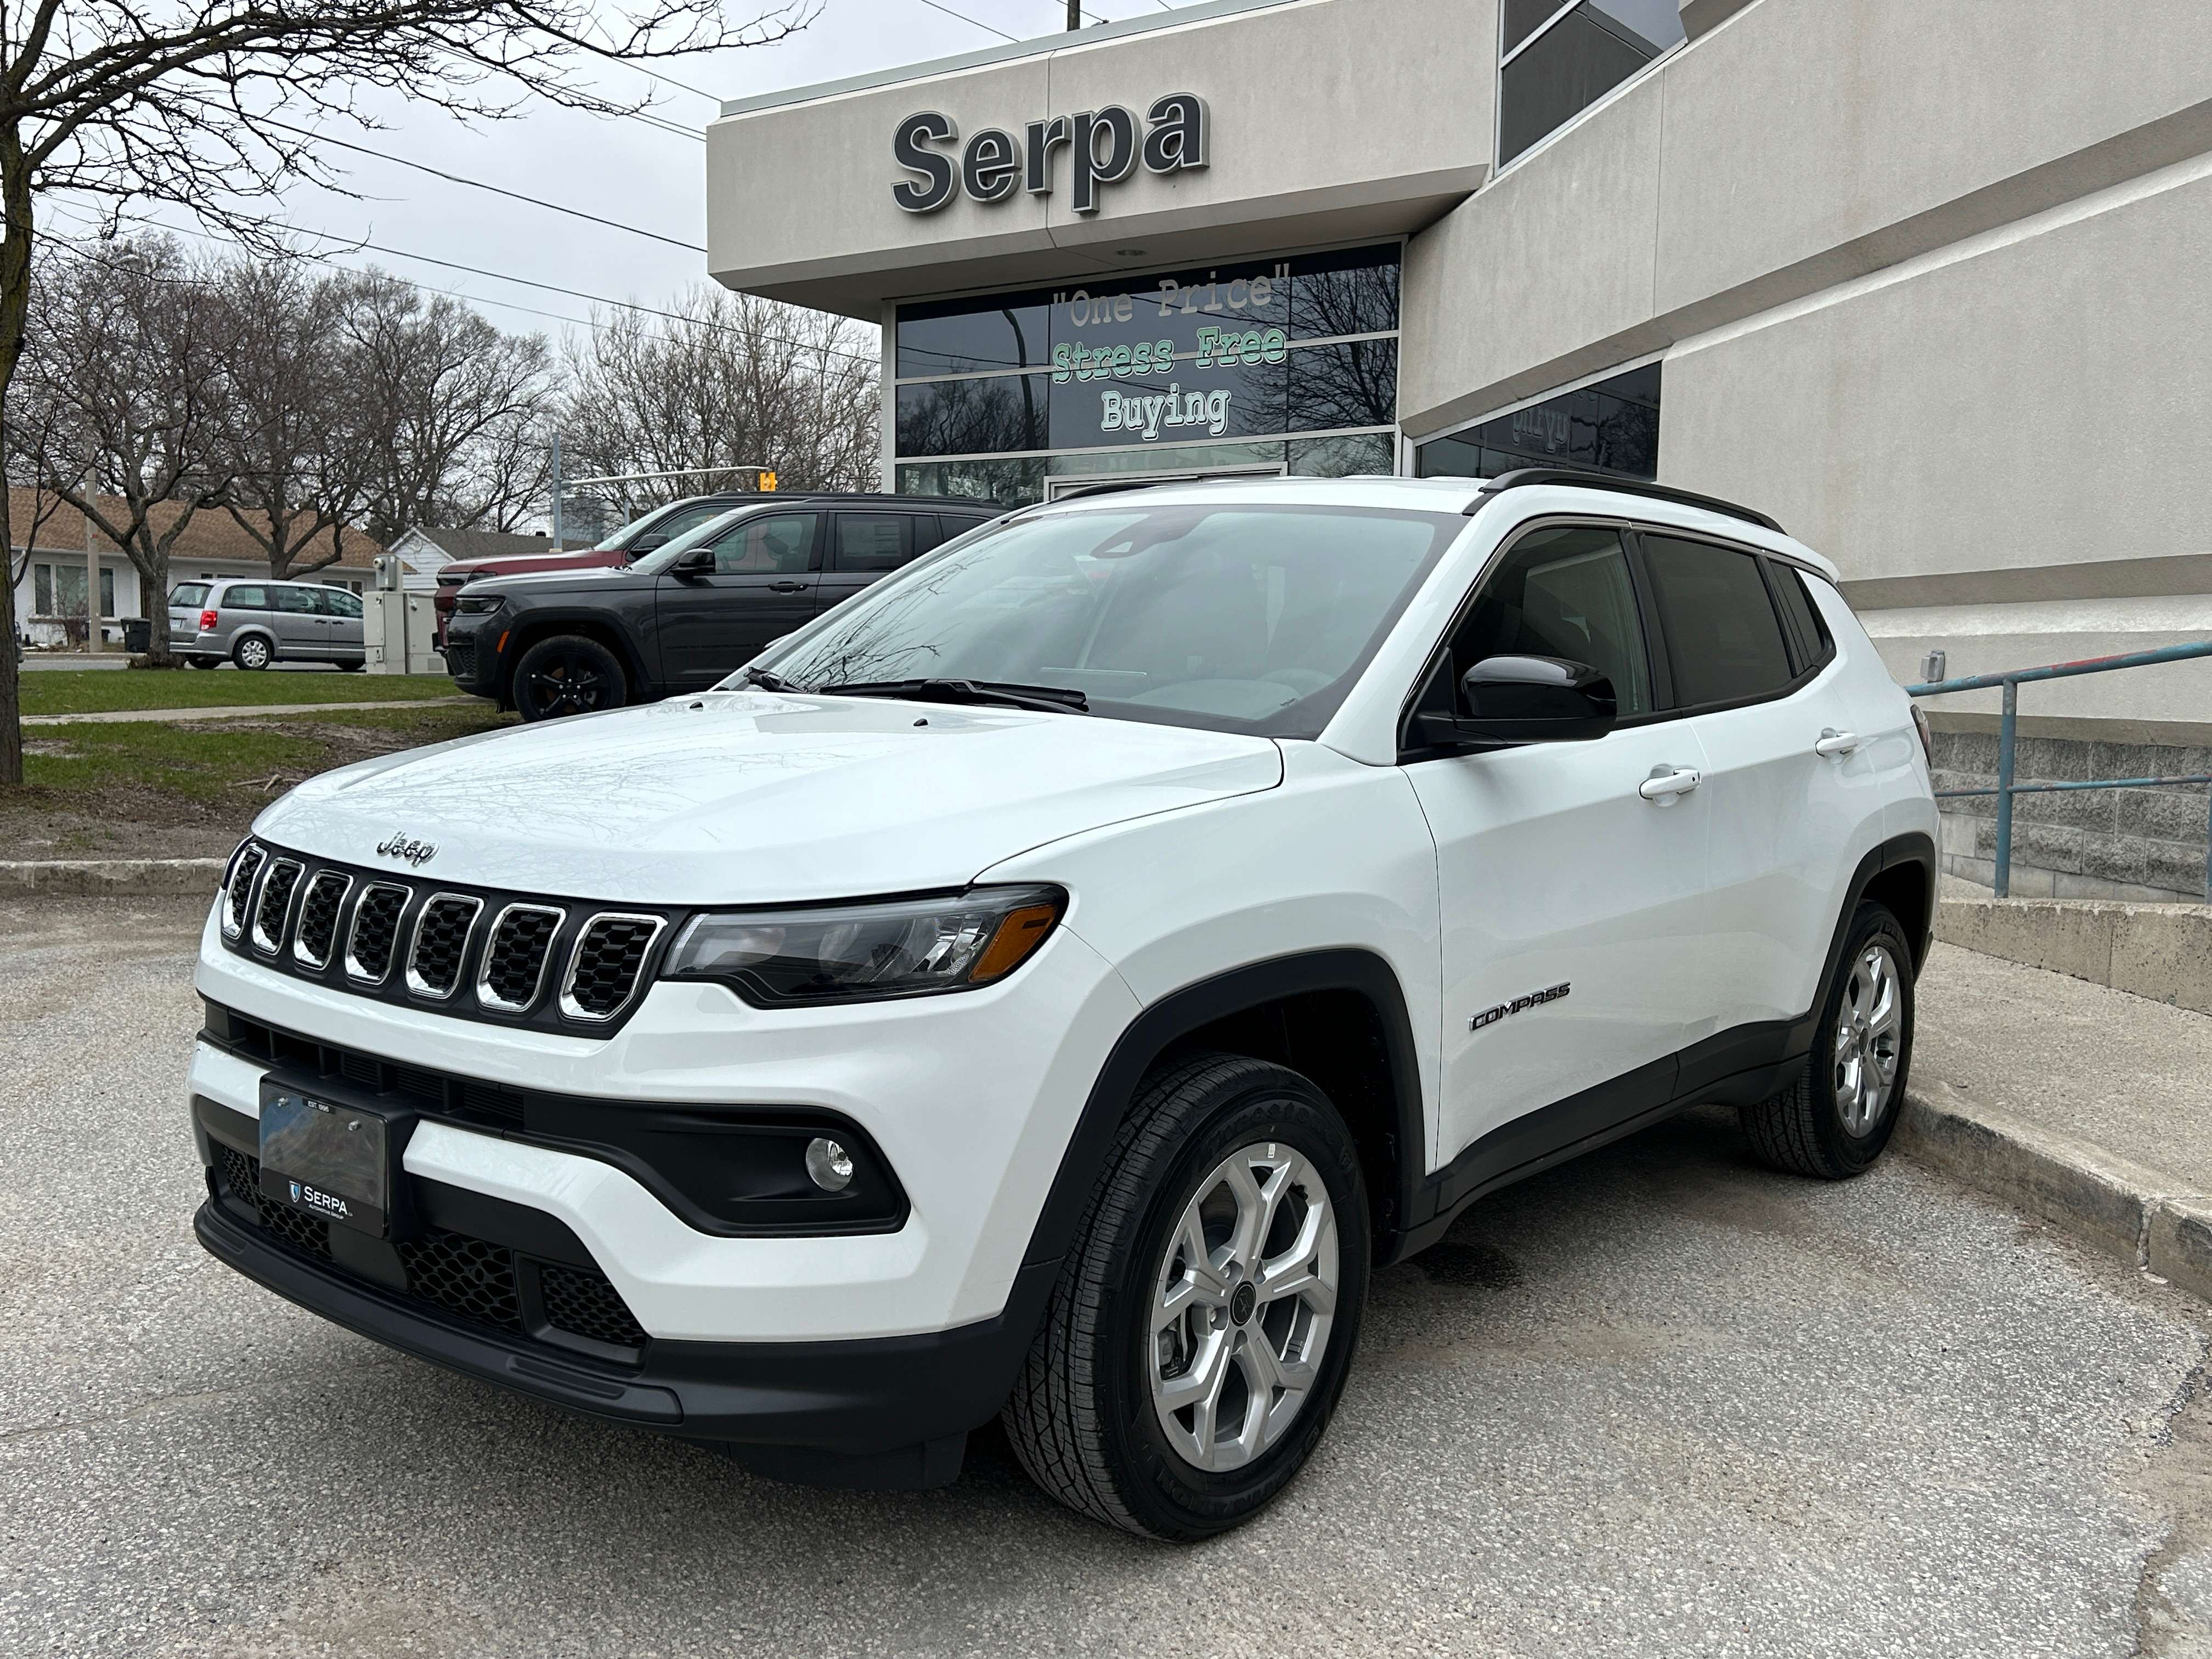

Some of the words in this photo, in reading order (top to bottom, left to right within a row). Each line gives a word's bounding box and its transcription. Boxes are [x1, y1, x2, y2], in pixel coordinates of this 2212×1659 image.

[890, 92, 1210, 215] Serpa
[1053, 290, 1133, 327] "One
[1158, 263, 1289, 317] Price"
[1052, 340, 1175, 383] Stress
[1196, 326, 1287, 368] Free
[1101, 383, 1232, 440] Buying
[376, 830, 439, 867] Jeep
[1466, 981, 1571, 1031] COMPASS
[304, 1186, 348, 1215] SERPA
